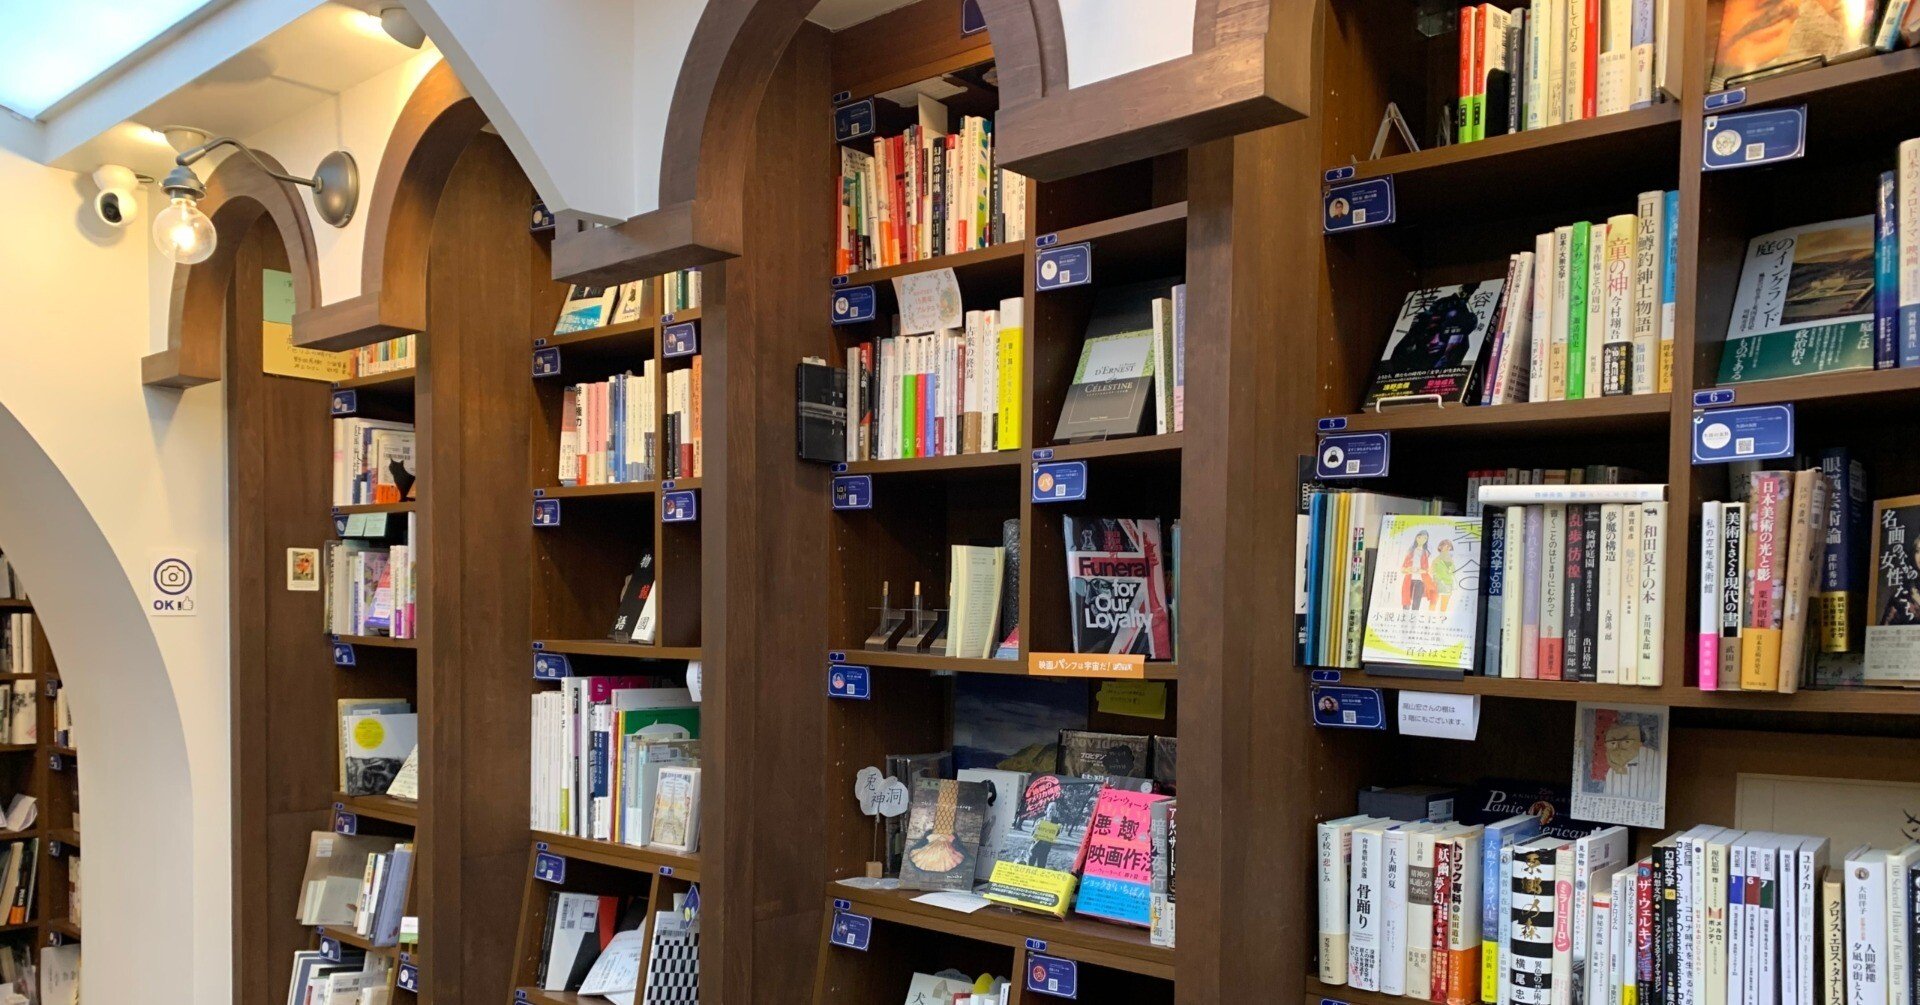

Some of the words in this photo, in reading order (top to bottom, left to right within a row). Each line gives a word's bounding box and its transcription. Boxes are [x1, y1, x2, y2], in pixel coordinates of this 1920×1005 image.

[1608, 237, 1629, 296] 童の神
[1635, 202, 1655, 333] 日光鱒釣紳士物語
[1711, 392, 1718, 402] 6
[1329, 420, 1335, 428] 5
[1605, 511, 1616, 562] 夢魔の構造
[1757, 481, 1774, 582] 日本美術の光と影
[1079, 557, 1150, 577] Funeral
[1547, 510, 1558, 616] 書くことのはじまりにむかって
[1642, 525, 1657, 604] 和田夏十の本
[1704, 518, 1714, 594] 私の空想美術館
[1723, 511, 1740, 628] 美術でさぐる現代の書
[153, 599, 174, 611] OK
[1095, 594, 1130, 612] Our
[1113, 581, 1137, 598] for
[1085, 609, 1154, 633] Loyalty
[1323, 671, 1329, 680] 7
[1482, 790, 1524, 814] Panic
[1094, 813, 1151, 841] 悪趣
[1321, 832, 1331, 882] 学校の悲しみ
[1388, 848, 1397, 889] 五大湖の夏
[1452, 841, 1463, 904] トリック専科
[1665, 850, 1675, 887] 幻想文学
[1803, 855, 1811, 890] ユリイカ
[1486, 840, 1496, 921] 大阪アースダイバー
[1859, 886, 1867, 915] 大田洋子
[1356, 884, 1371, 929] 骨踊り
[1557, 884, 1567, 948] ミラーニューロン
[1638, 879, 1652, 950] ザ・ウェルキン
[1451, 913, 1460, 945] 松田道弘
[1830, 900, 1841, 1005] クロノス・エロス・タナトス
